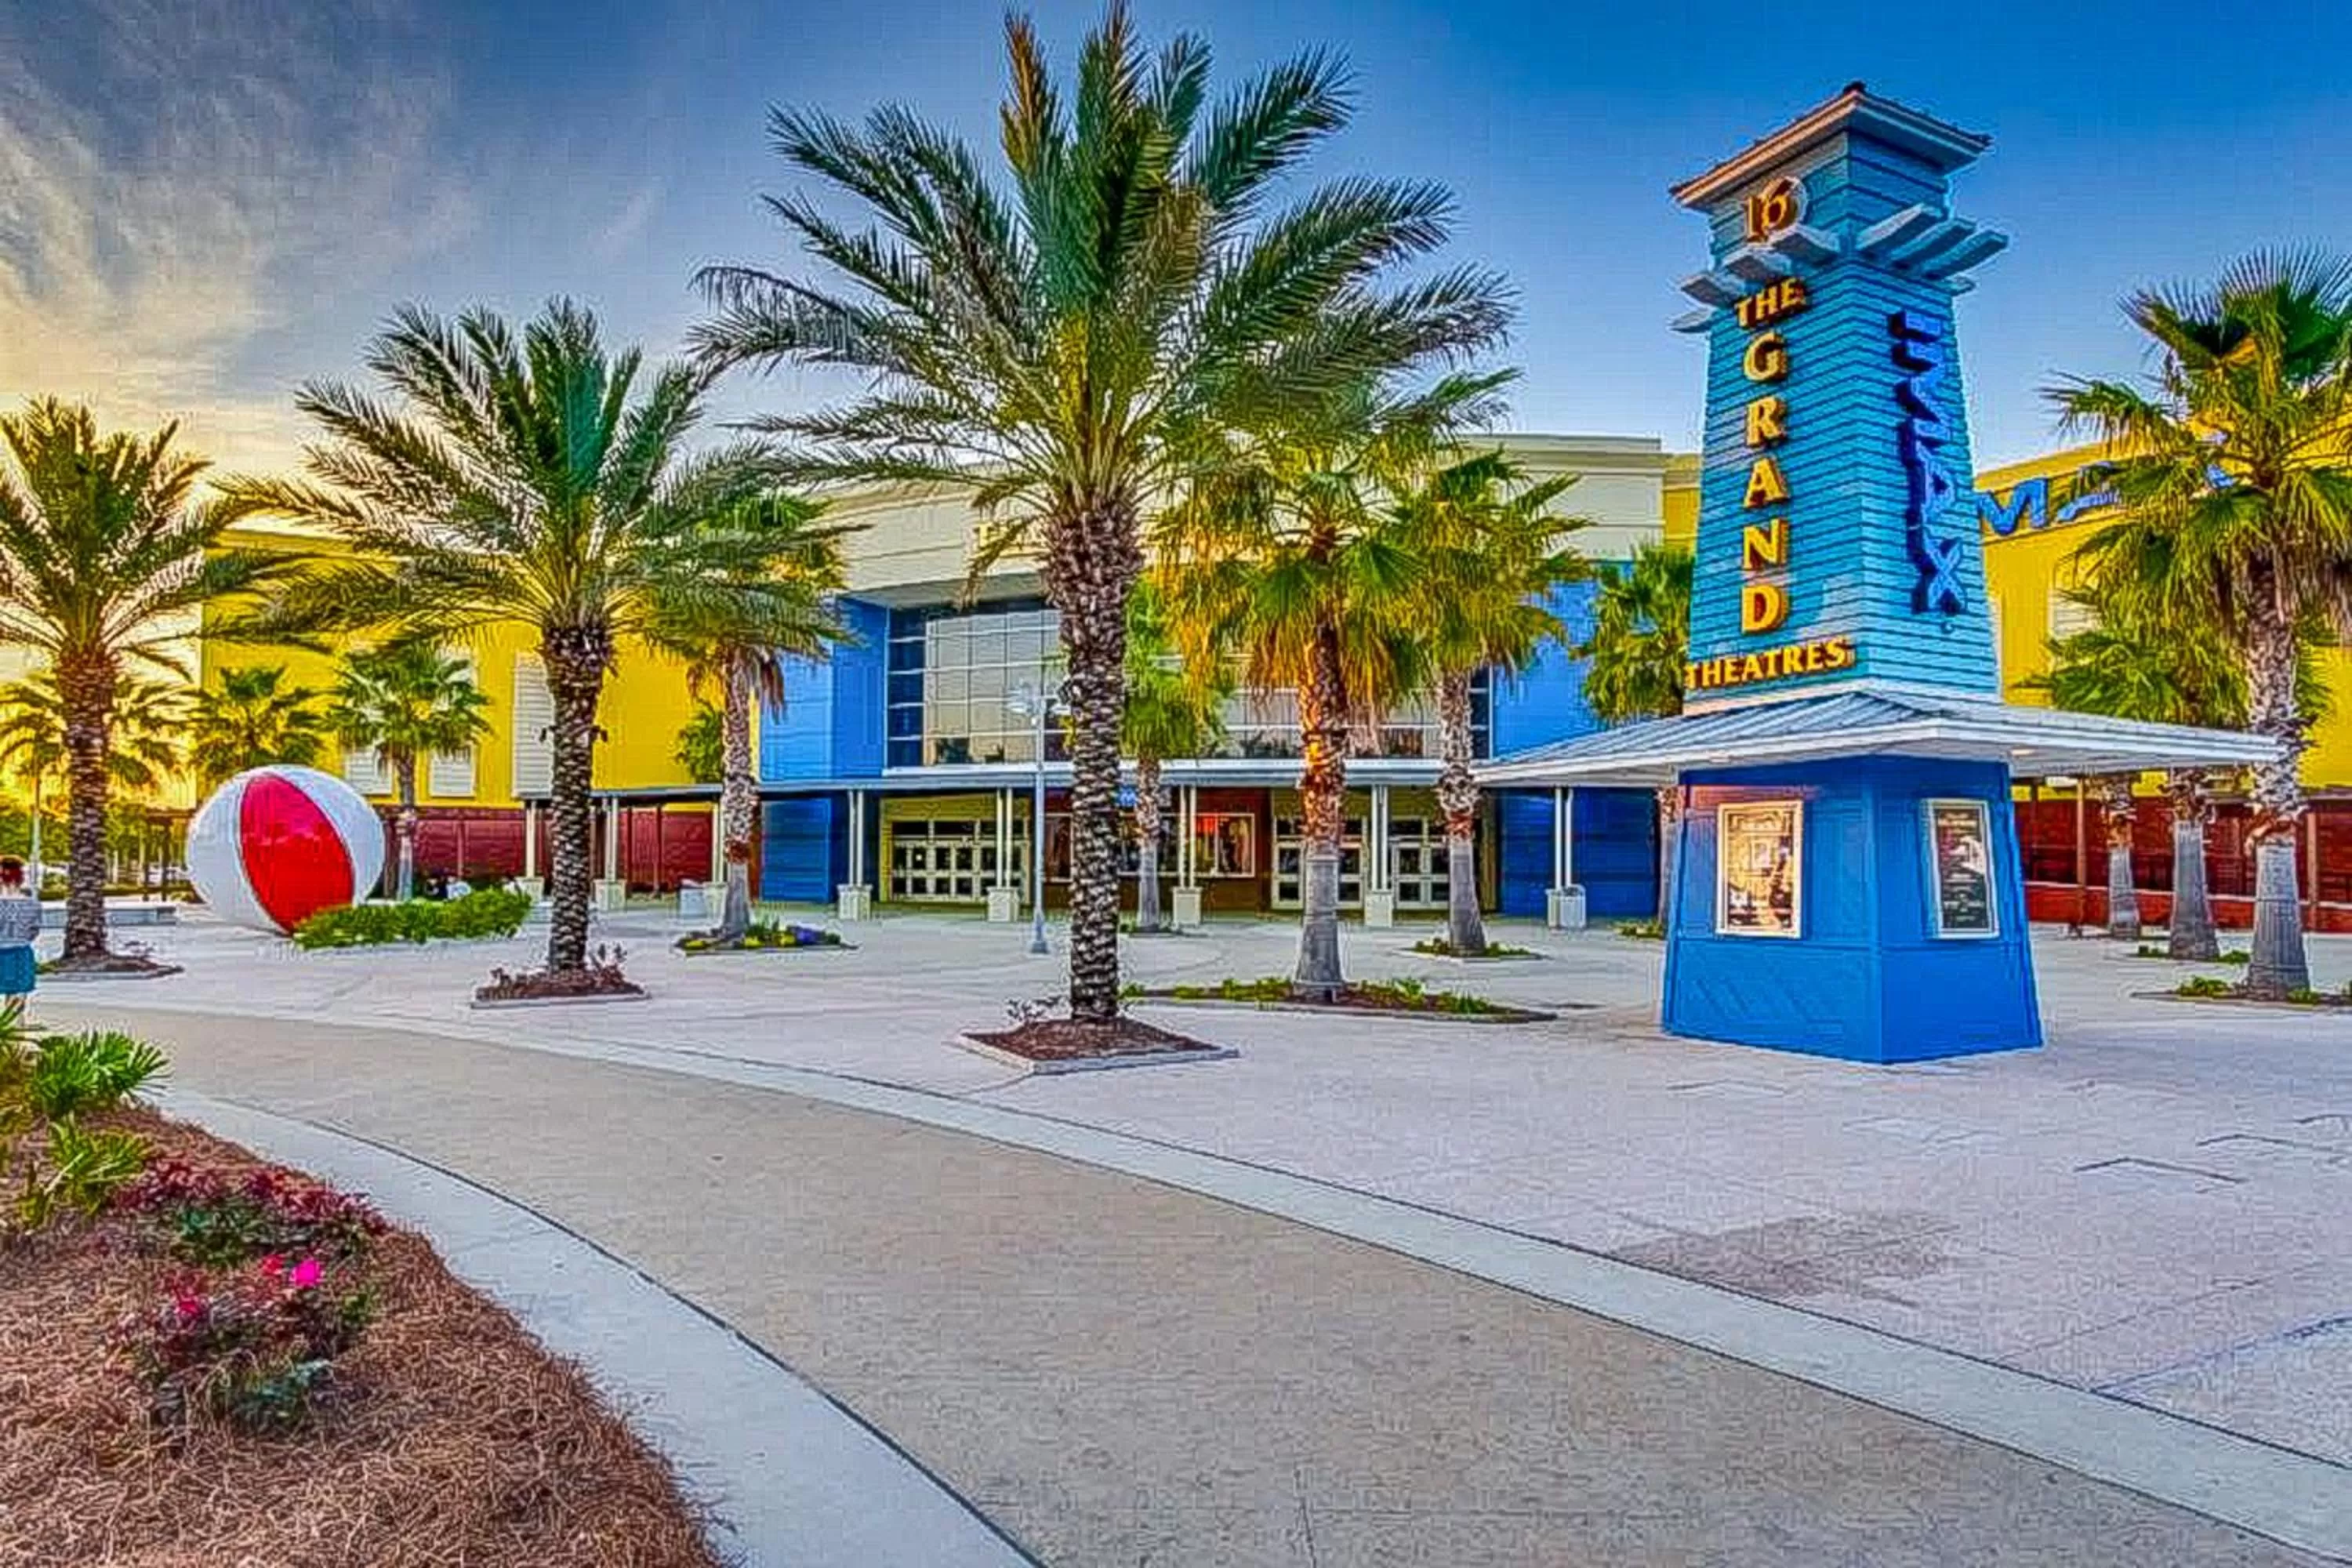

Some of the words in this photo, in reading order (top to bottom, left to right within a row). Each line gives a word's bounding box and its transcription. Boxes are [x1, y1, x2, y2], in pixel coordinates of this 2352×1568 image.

[1745, 177, 1797, 241] 16
[1735, 278, 1806, 329] THE
[1741, 331, 1788, 633] GRAND
[1891, 310, 1966, 615] IMAX
[1685, 636, 1852, 688] THEATRES
